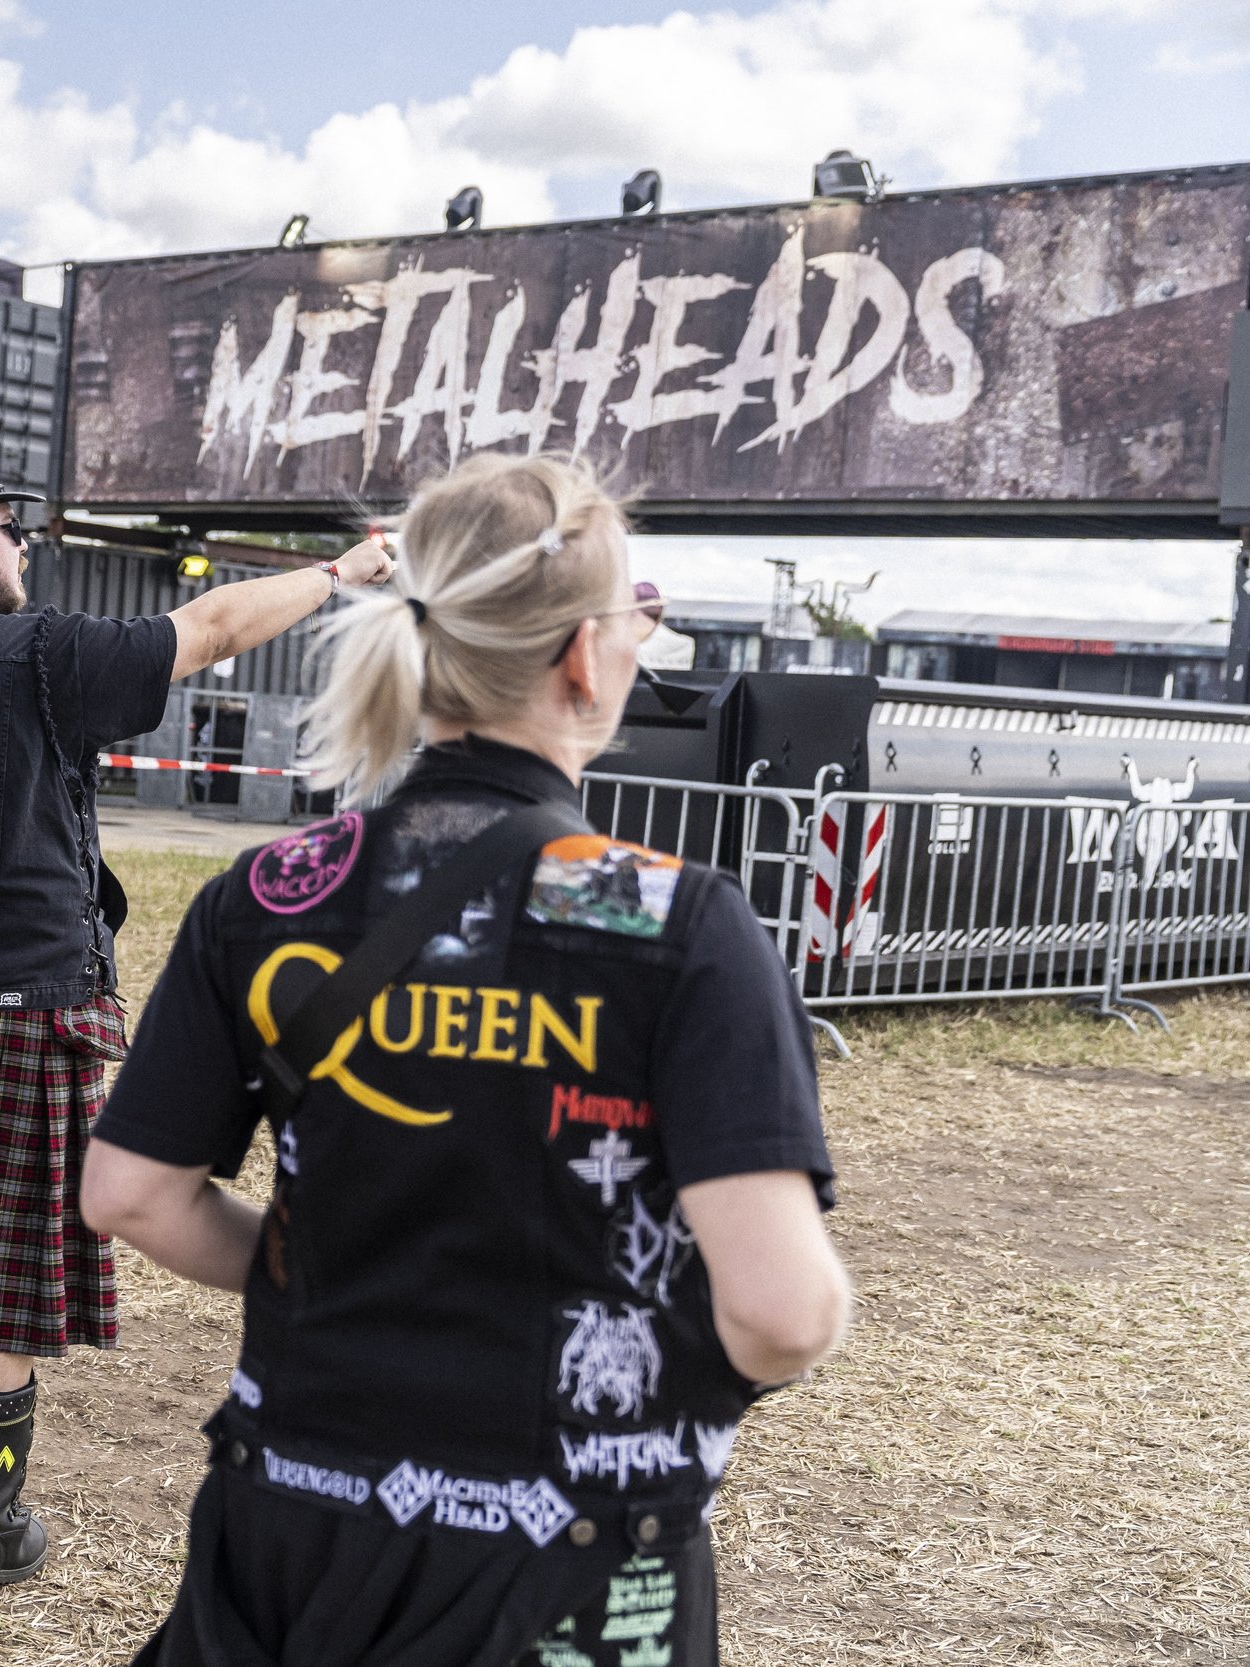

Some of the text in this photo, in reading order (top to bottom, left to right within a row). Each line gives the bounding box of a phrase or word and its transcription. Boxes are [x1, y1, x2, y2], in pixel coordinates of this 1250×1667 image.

[198, 224, 1005, 490] METALHEADS
[248, 942, 603, 1126] QUEEN
[262, 1447, 371, 1506] VERSENGOLD
[415, 1467, 530, 1508] MACHINE
[433, 1499, 510, 1532] HEAD
